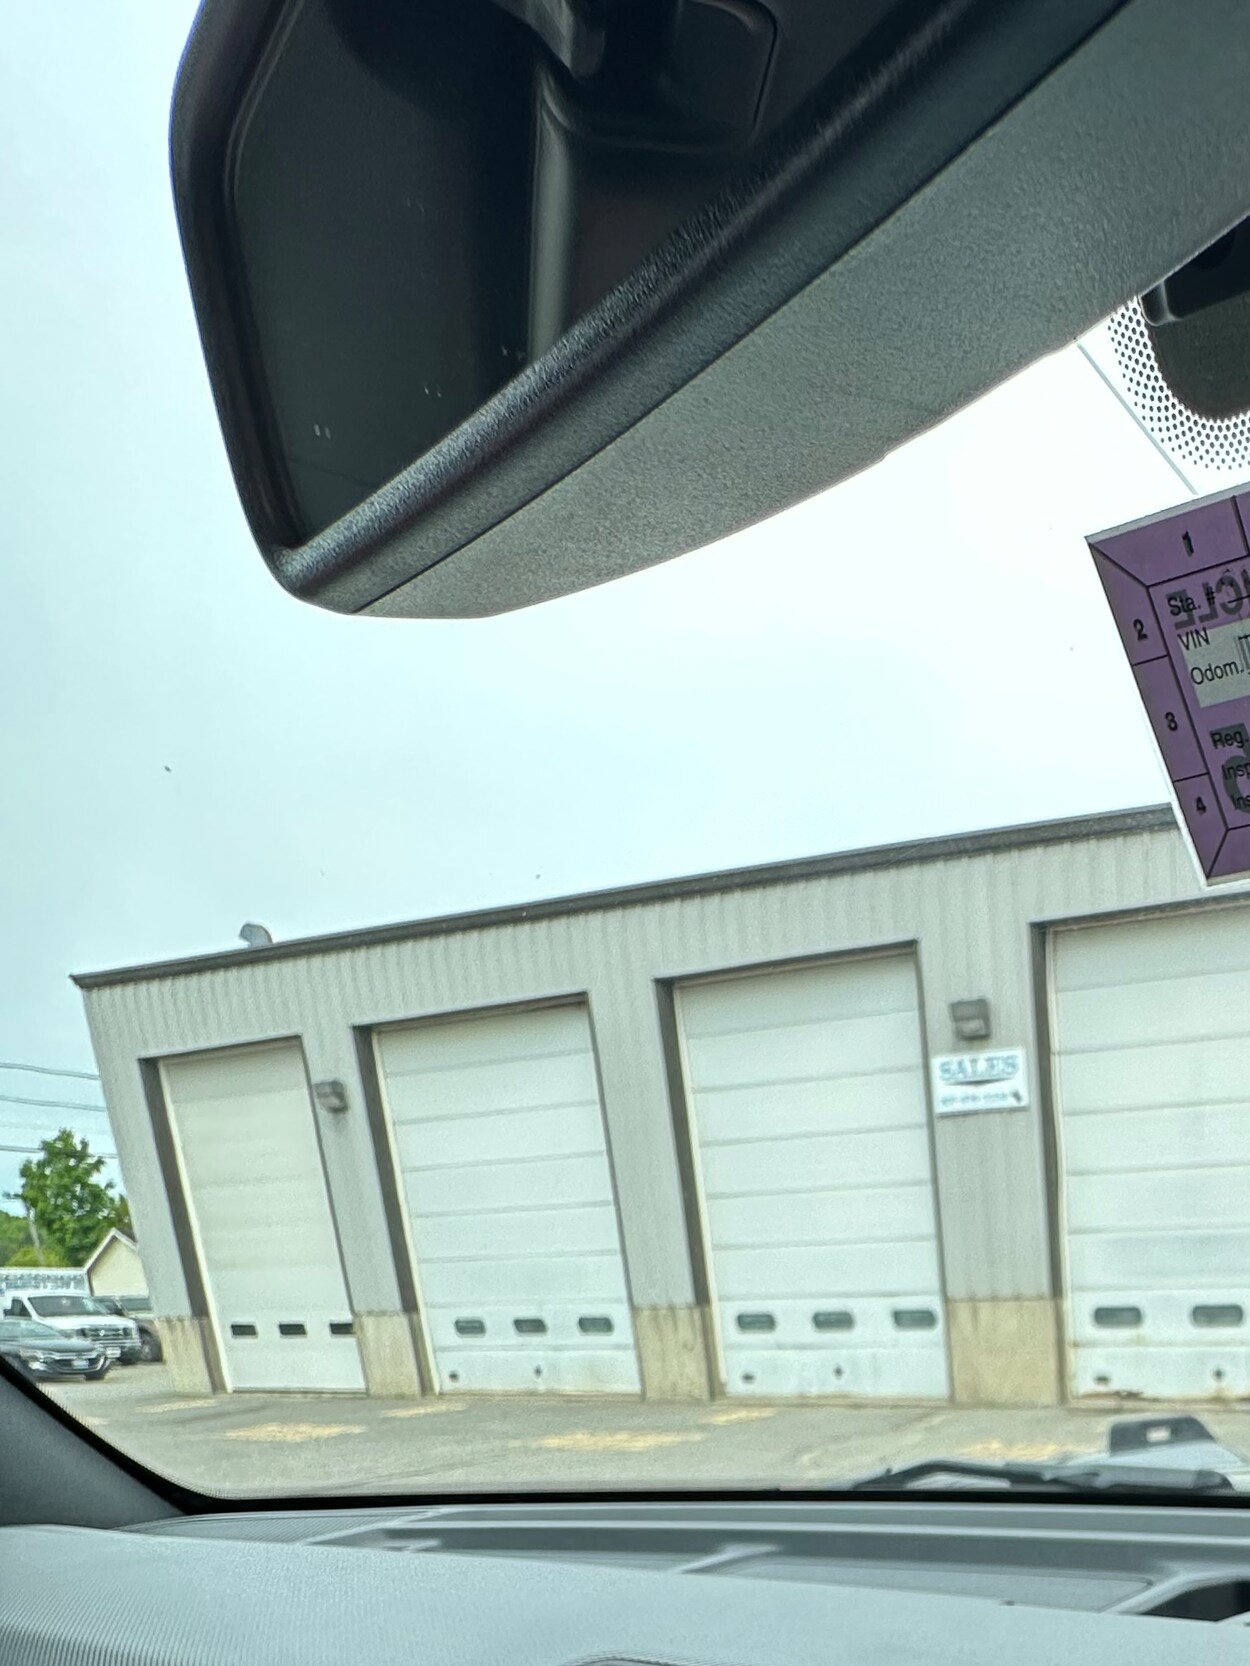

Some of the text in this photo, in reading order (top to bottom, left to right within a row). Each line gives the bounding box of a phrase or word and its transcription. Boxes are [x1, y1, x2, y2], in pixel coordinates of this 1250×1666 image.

[1181, 531, 1194, 557] 1
[1133, 619, 1147, 641] 2
[1177, 627, 1210, 650] VIN
[1191, 661, 1245, 685] Odom.
[1165, 712, 1178, 732] 3
[1210, 731, 1250, 749] Reg.
[1196, 797, 1207, 815] 4
